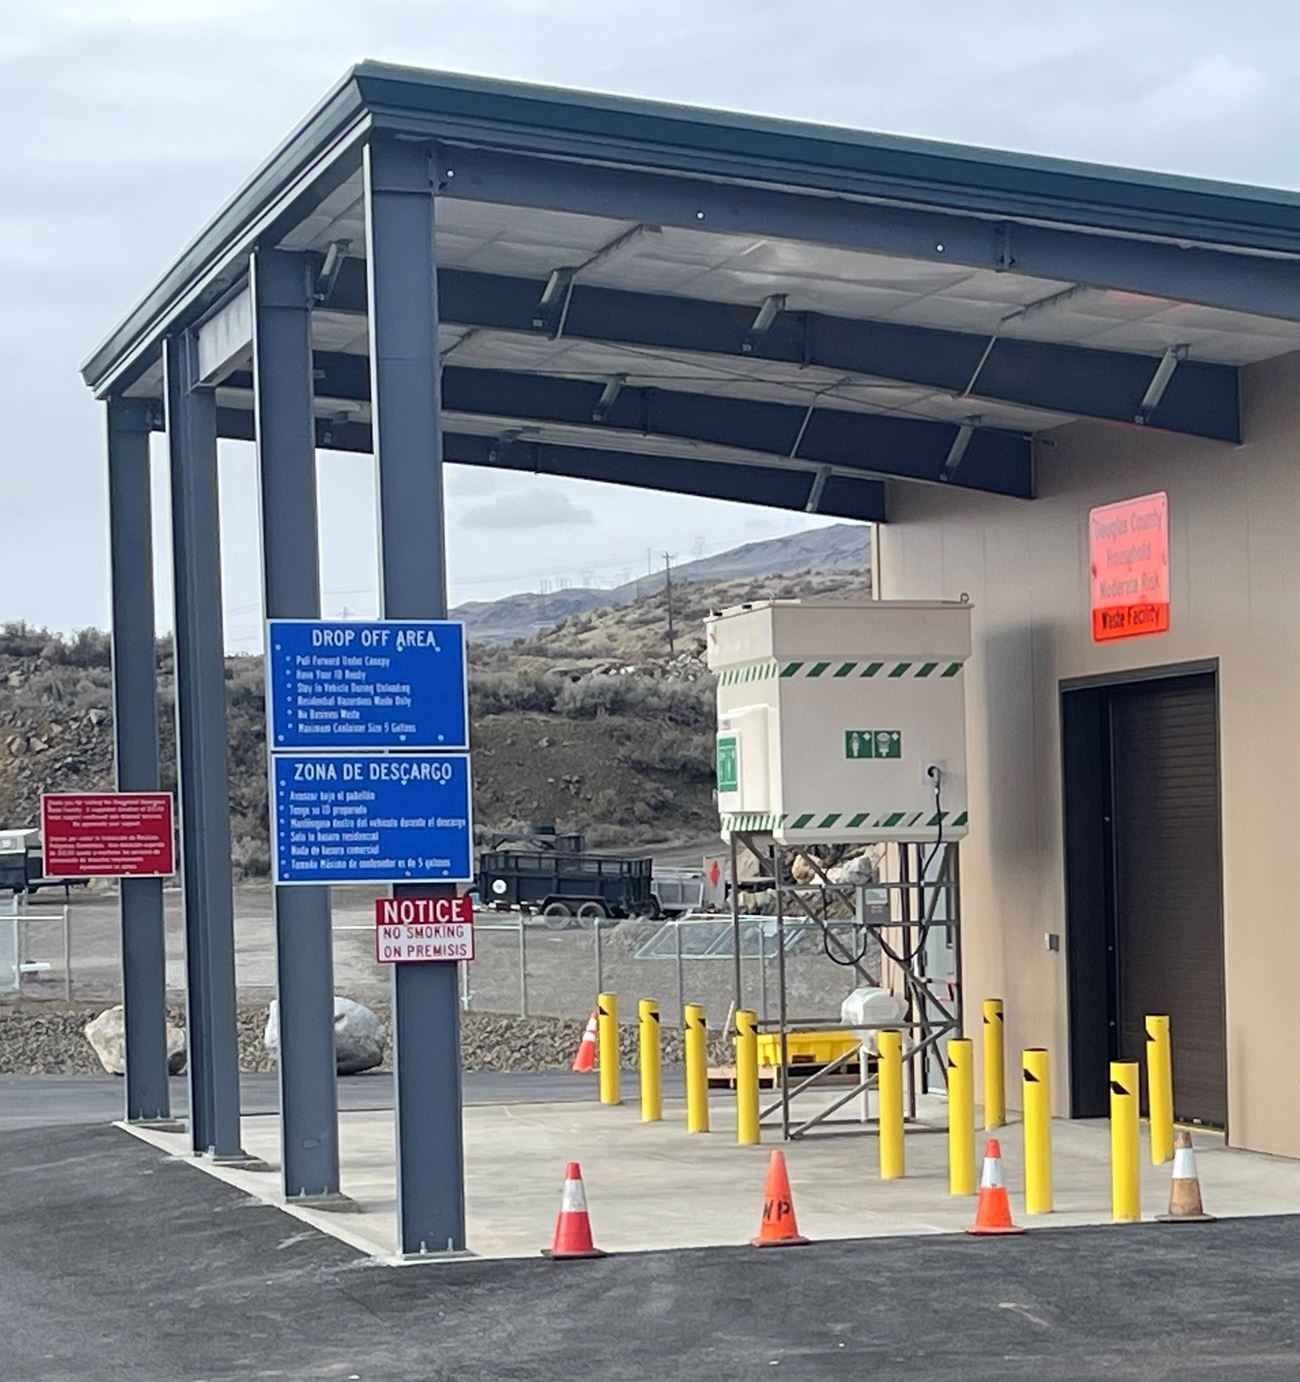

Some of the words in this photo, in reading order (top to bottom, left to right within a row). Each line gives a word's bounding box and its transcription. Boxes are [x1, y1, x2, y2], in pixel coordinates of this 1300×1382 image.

[1095, 515, 1128, 542] Douglas
[1131, 509, 1162, 532] County
[1106, 542, 1151, 567] Household
[1100, 577, 1138, 599] Moderate
[1141, 571, 1160, 591] Risk
[1101, 611, 1125, 629] Waste
[1128, 605, 1159, 627] Facility
[312, 629, 355, 646] DROP
[361, 629, 390, 646] OFF
[396, 630, 437, 647] AREA
[294, 764, 337, 781] ZONA
[343, 764, 364, 781] DE
[370, 763, 452, 781] DESCARGO
[383, 900, 465, 923] NOTICE
[383, 927, 401, 939] NO
[406, 925, 464, 939] SMOKING
[384, 945, 401, 958] ON
[407, 944, 467, 957] PREMISIS
